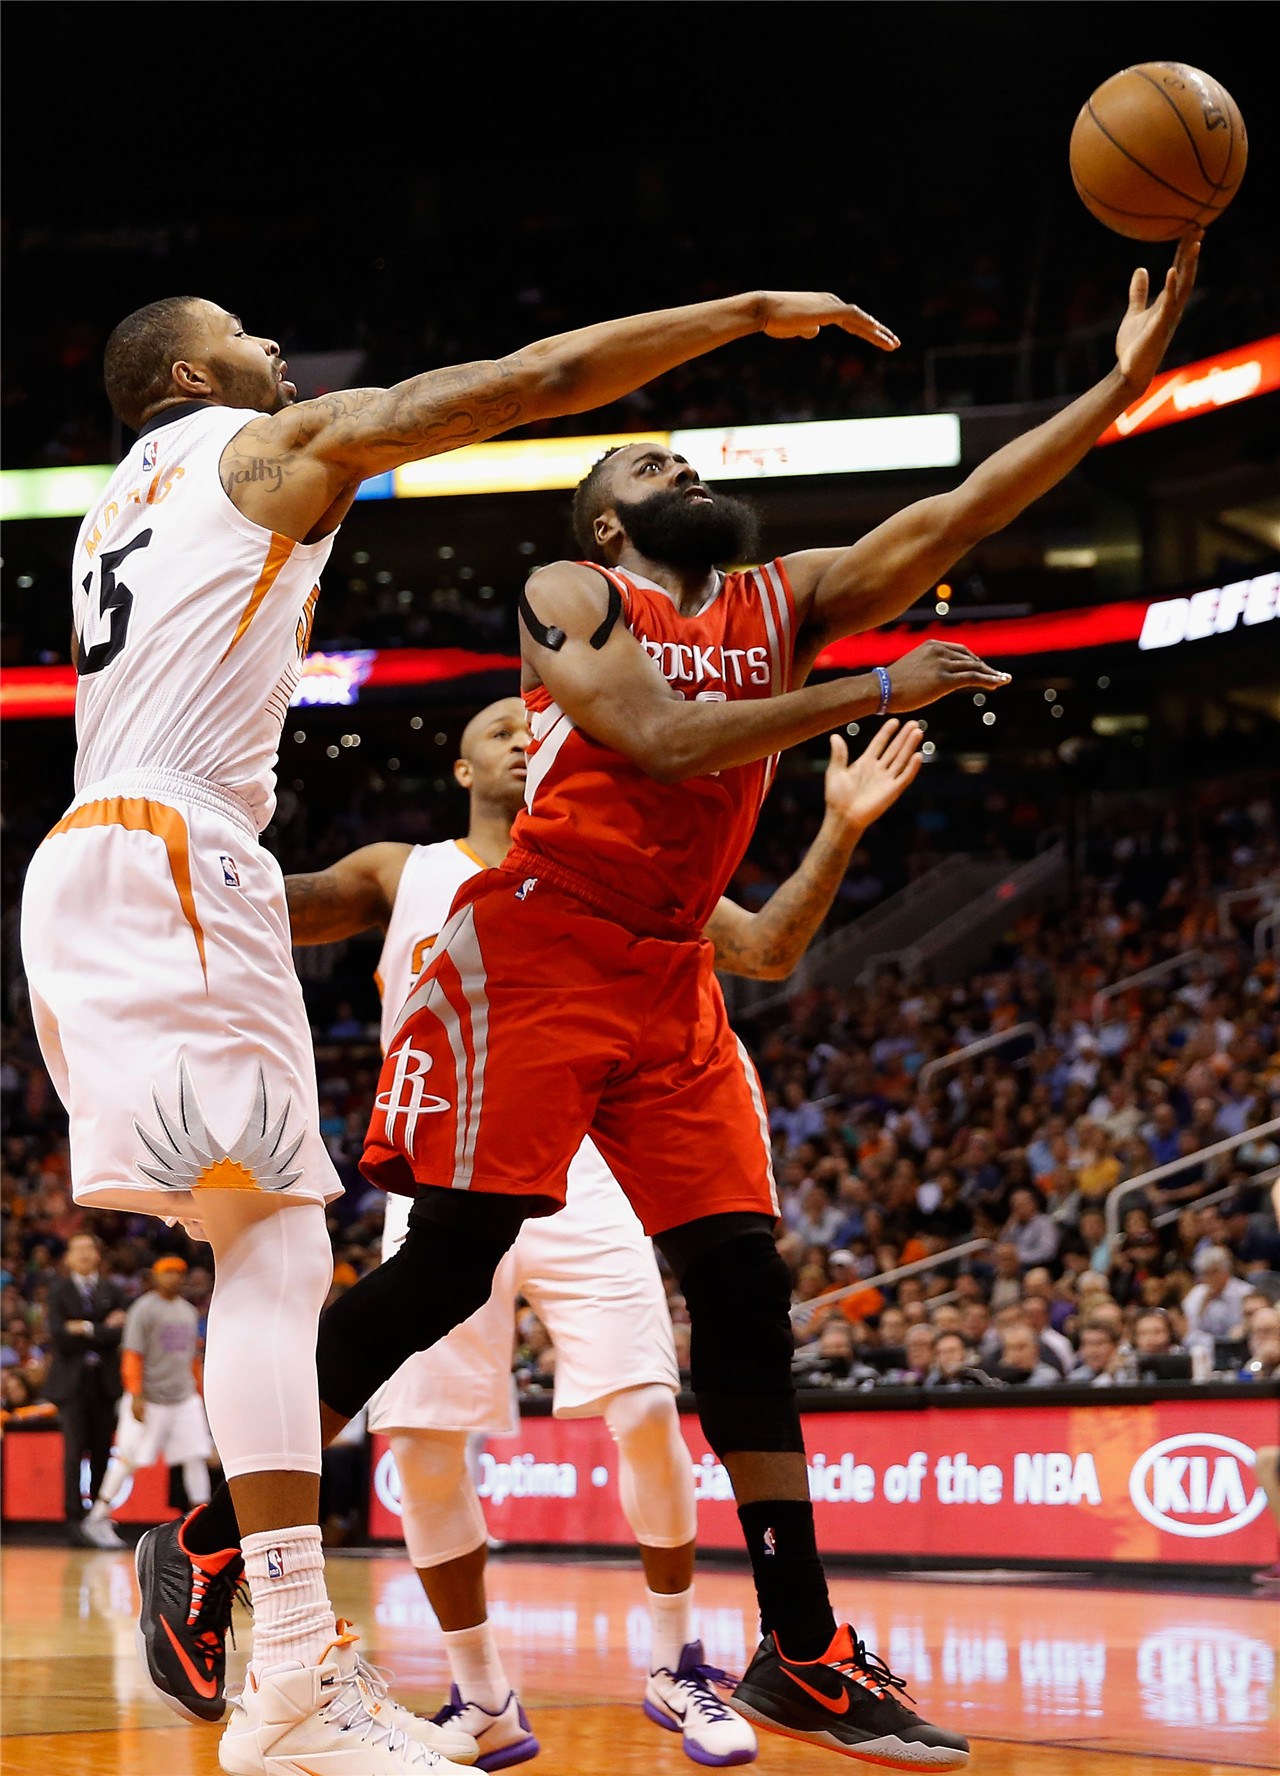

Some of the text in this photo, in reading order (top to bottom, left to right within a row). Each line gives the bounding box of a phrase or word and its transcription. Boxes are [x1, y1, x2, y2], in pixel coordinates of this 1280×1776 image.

[1138, 571, 1280, 651] DEFE
[883, 1451, 929, 1504] of
[935, 1451, 1003, 1505] the
[1013, 1452, 1102, 1506] NBA
[1152, 1456, 1248, 1514] KIA
